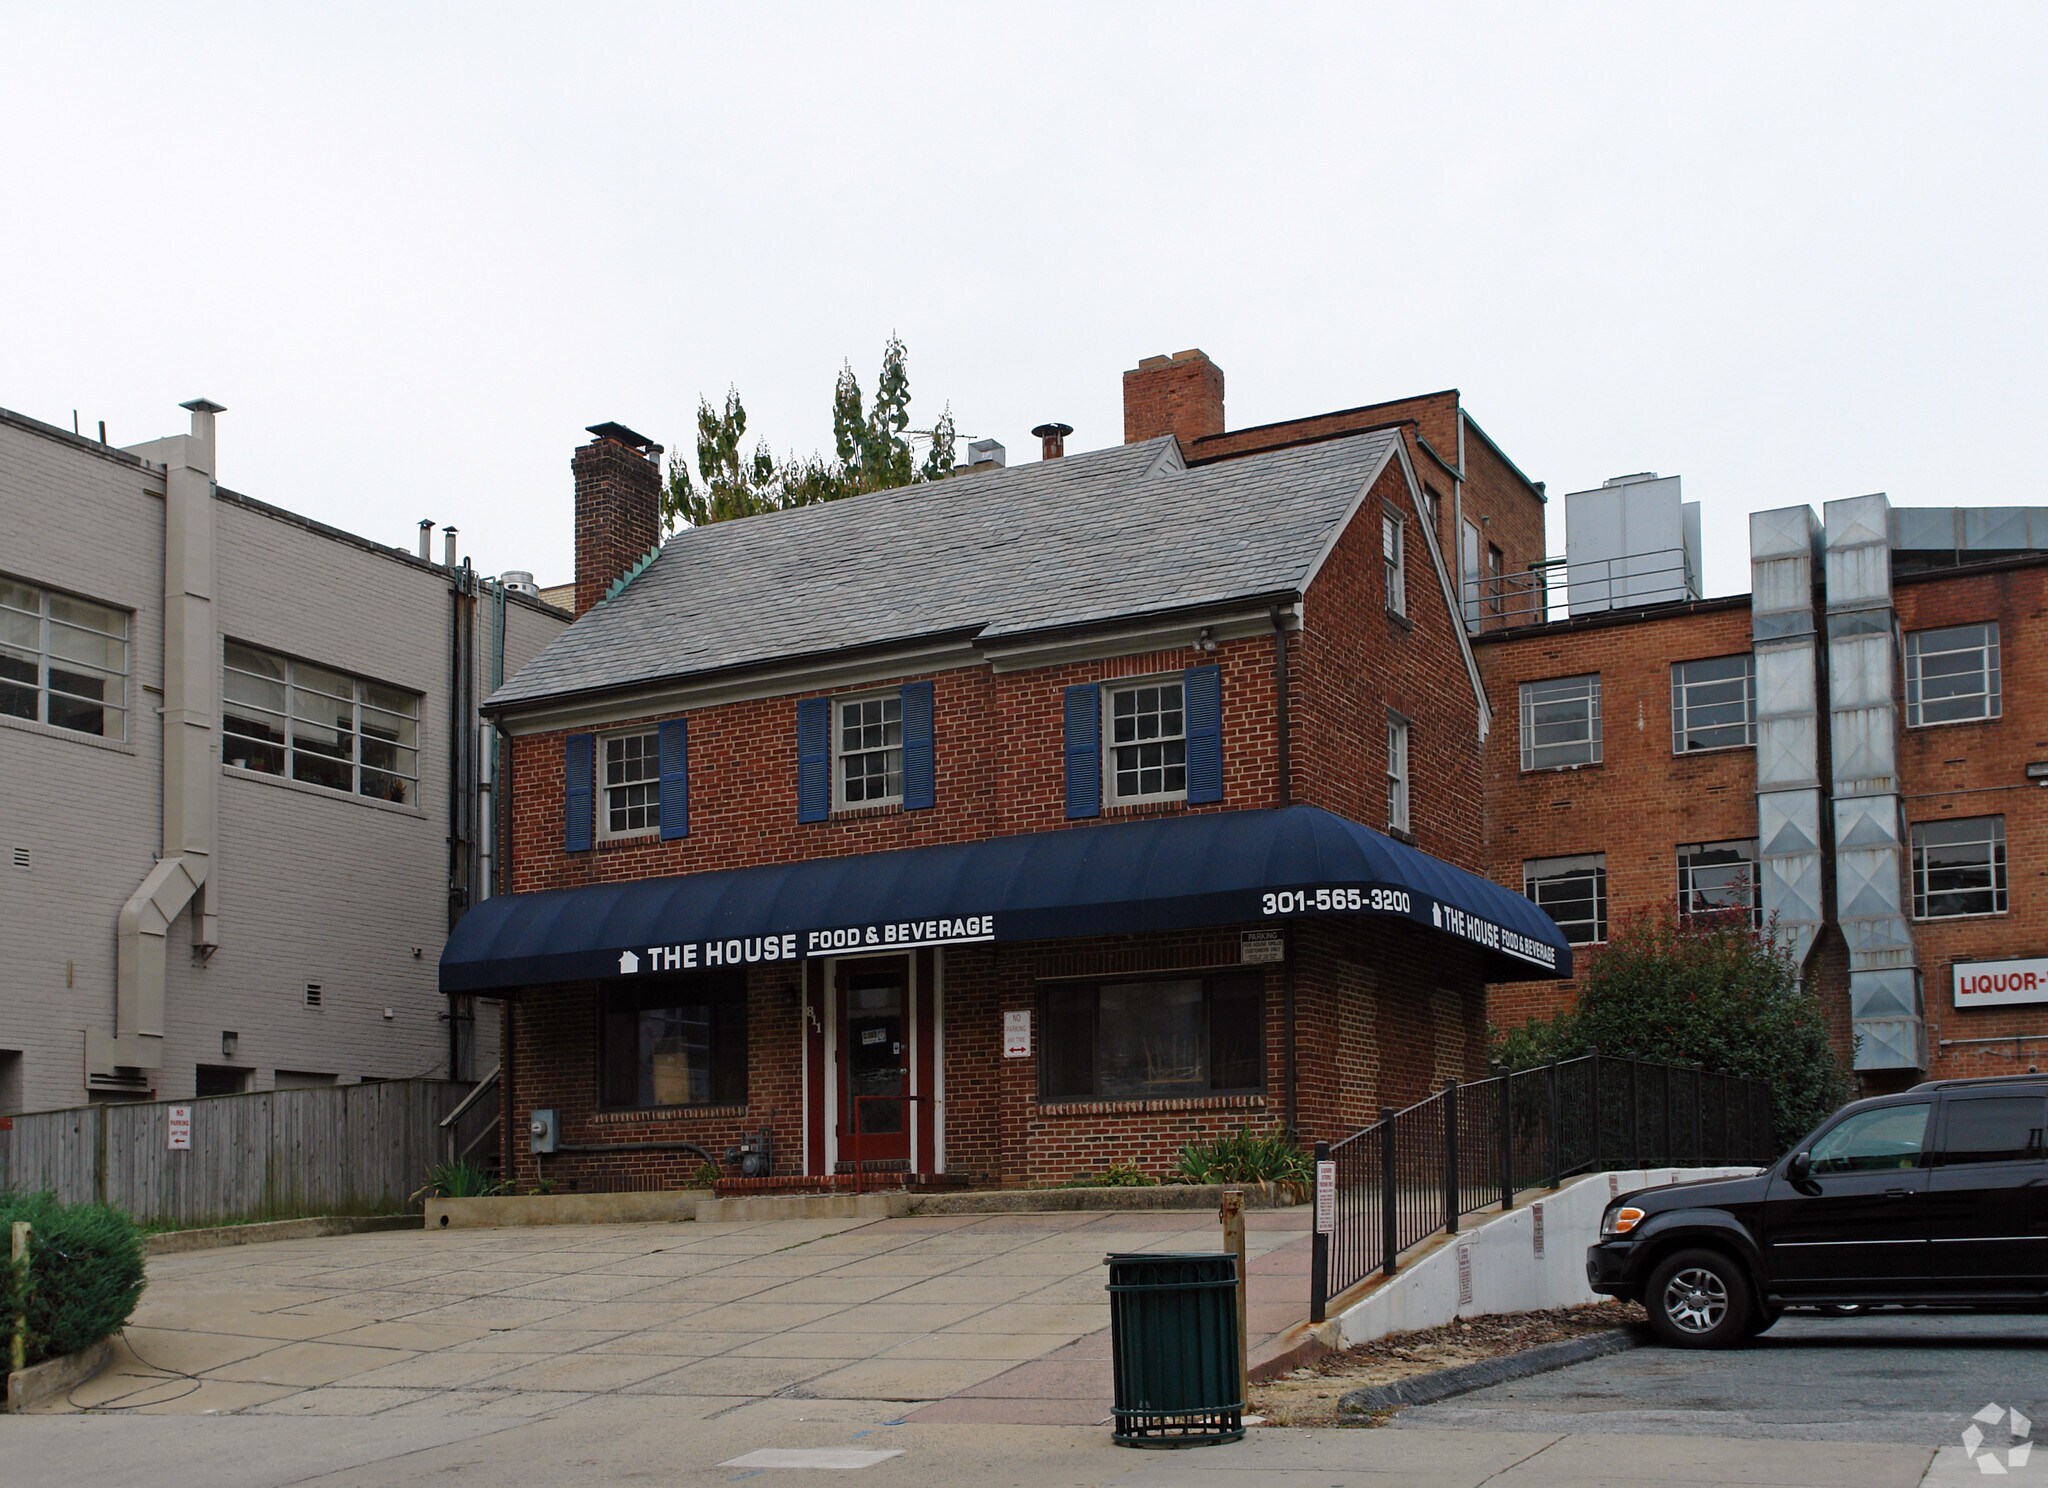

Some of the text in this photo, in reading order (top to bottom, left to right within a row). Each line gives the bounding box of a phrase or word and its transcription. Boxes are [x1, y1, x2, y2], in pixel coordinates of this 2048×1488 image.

[1262, 888, 1411, 915] 301-565-3200
[648, 915, 994, 971] THE HOUSE FOOD & BEVERAGE
[1247, 932, 1278, 941] PARKING
[1443, 905, 1556, 964] THE HOUSE FOOD & BEVERAGE
[1960, 970, 2048, 995] LIQUOR-
[1012, 1013, 1022, 1022] NO
[176, 1109, 184, 1117] NO
